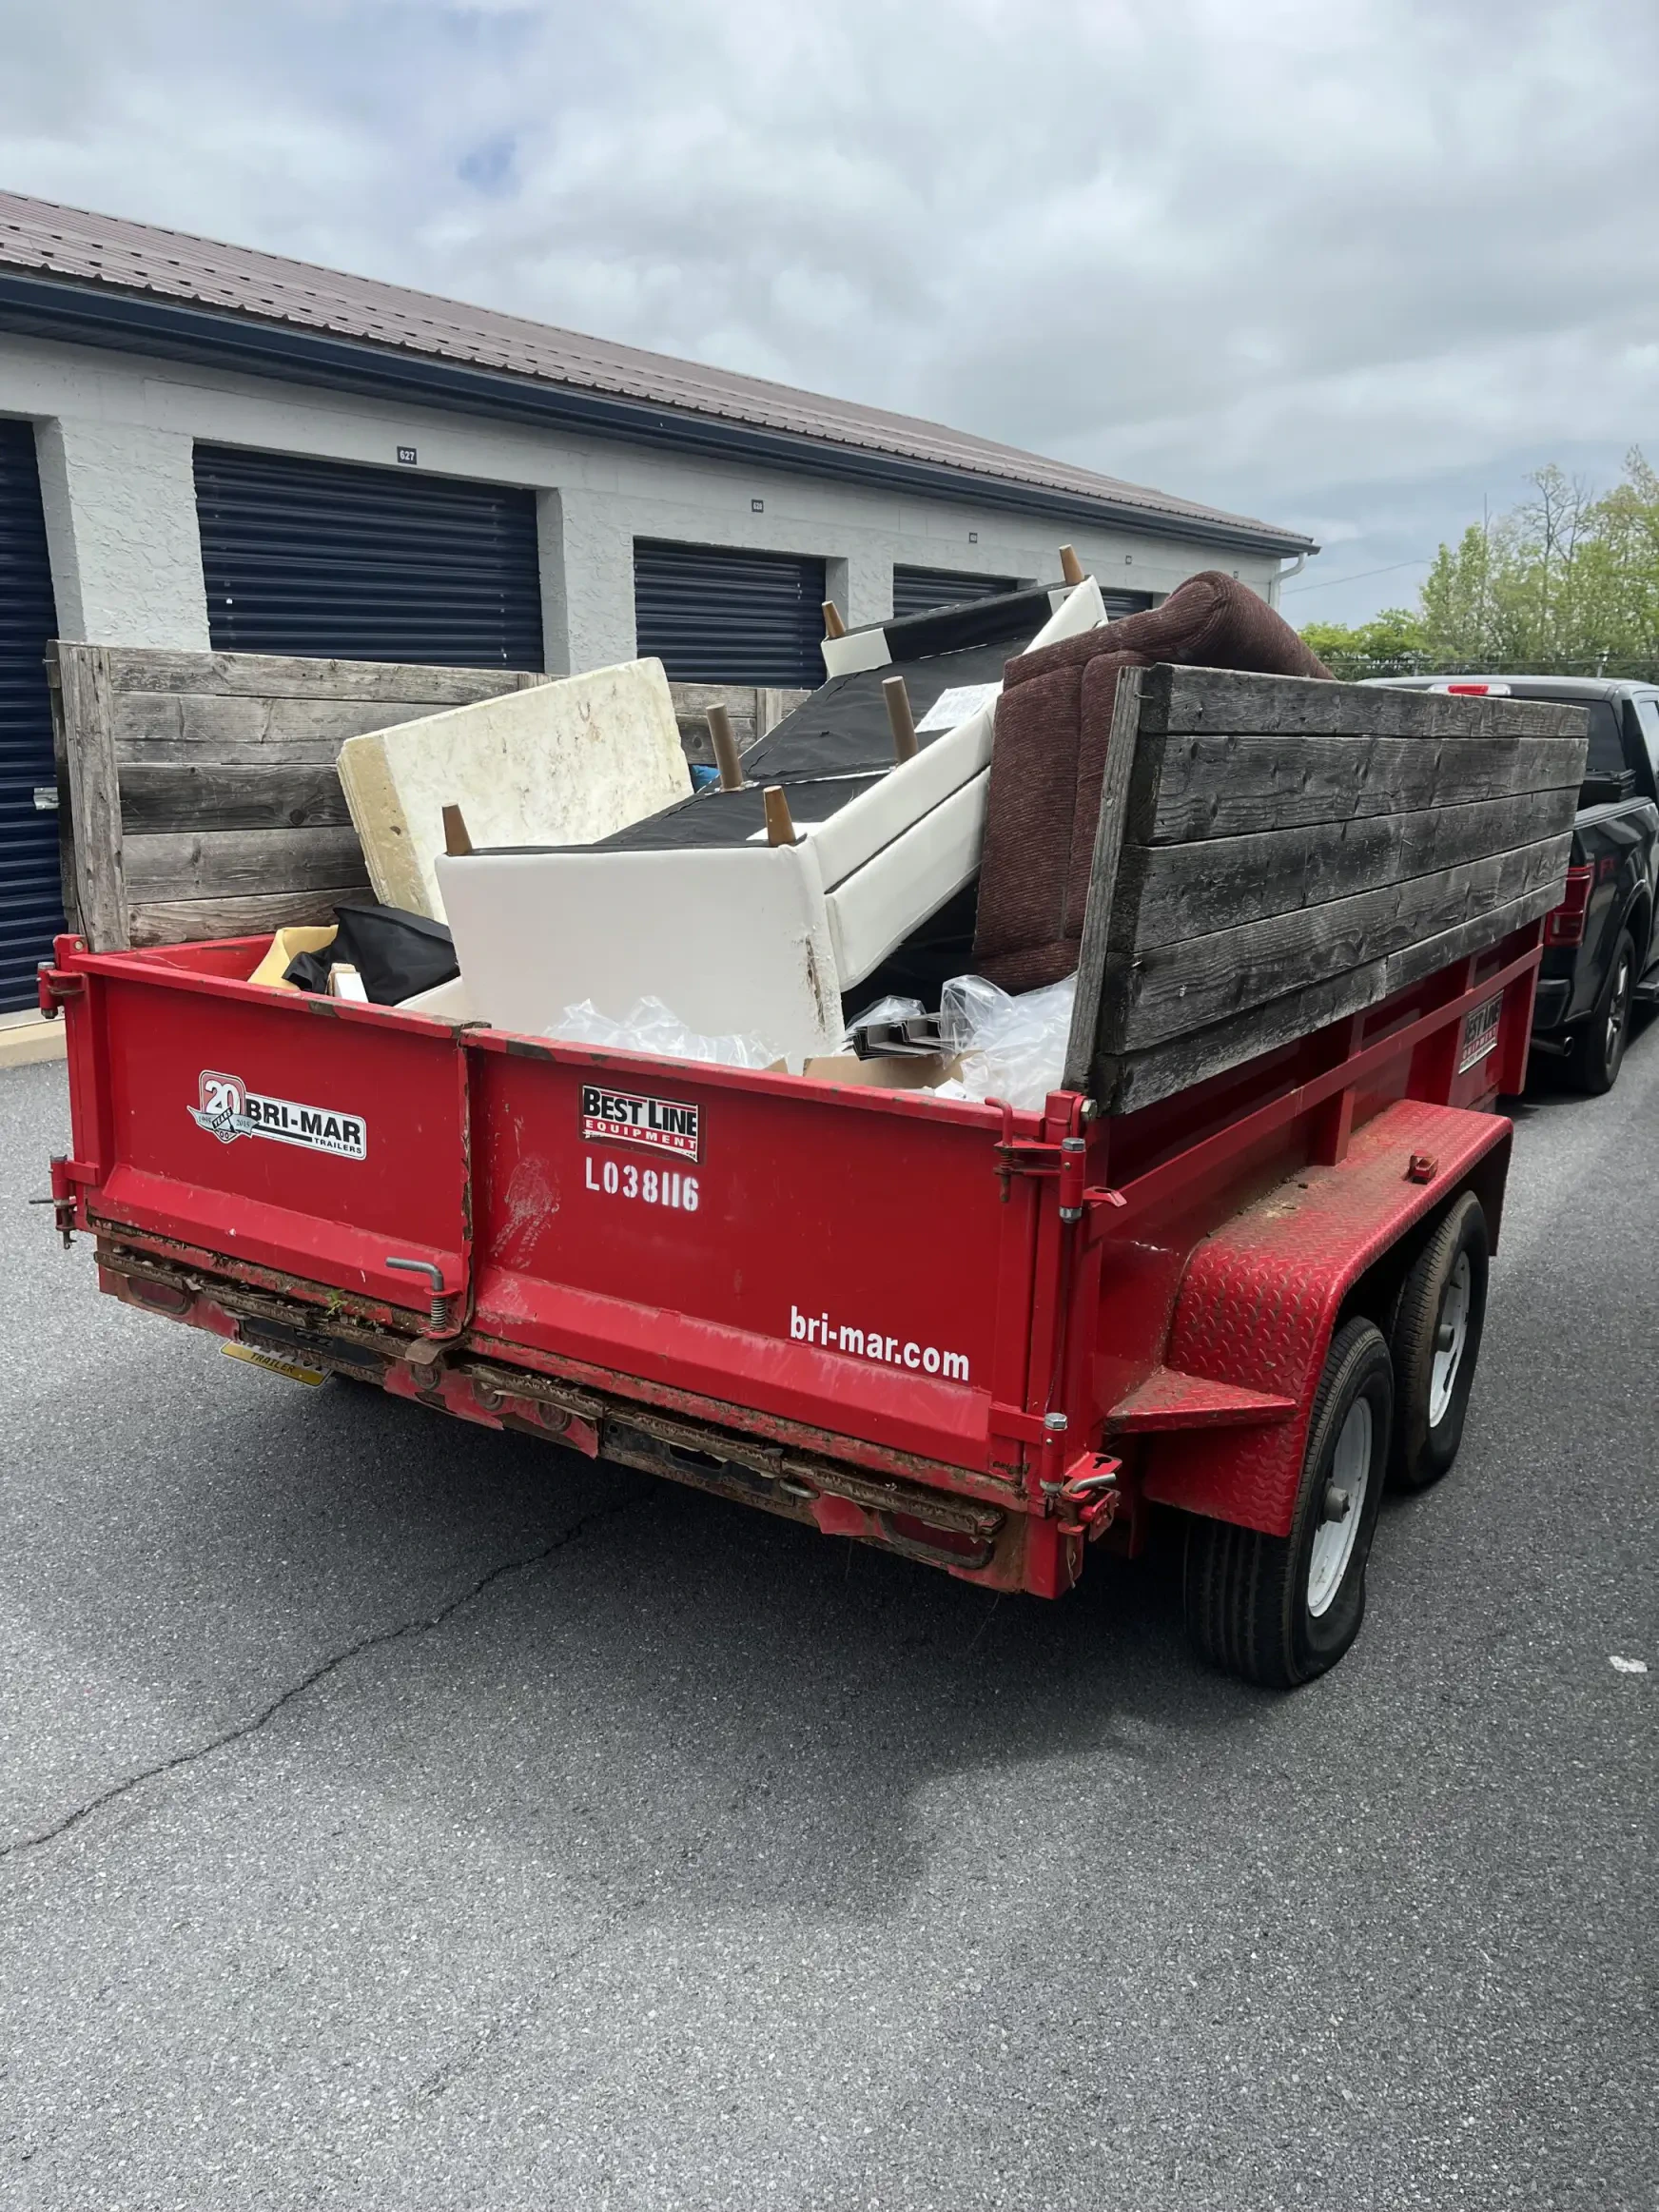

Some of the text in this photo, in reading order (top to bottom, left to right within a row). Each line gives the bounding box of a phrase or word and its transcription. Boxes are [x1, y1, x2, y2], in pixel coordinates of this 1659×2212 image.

[400, 449, 415, 461] 627
[205, 1079, 241, 1114] 20
[583, 1087, 697, 1137] BEST LINE
[245, 1098, 361, 1145] BRI-MAR
[585, 1119, 696, 1150] EQUIPMENT
[314, 1137, 362, 1154] TRAILERS
[585, 1156, 699, 1212] L038116
[790, 1304, 969, 1381] bri-mar.com
[249, 1352, 295, 1373] TRAILER
